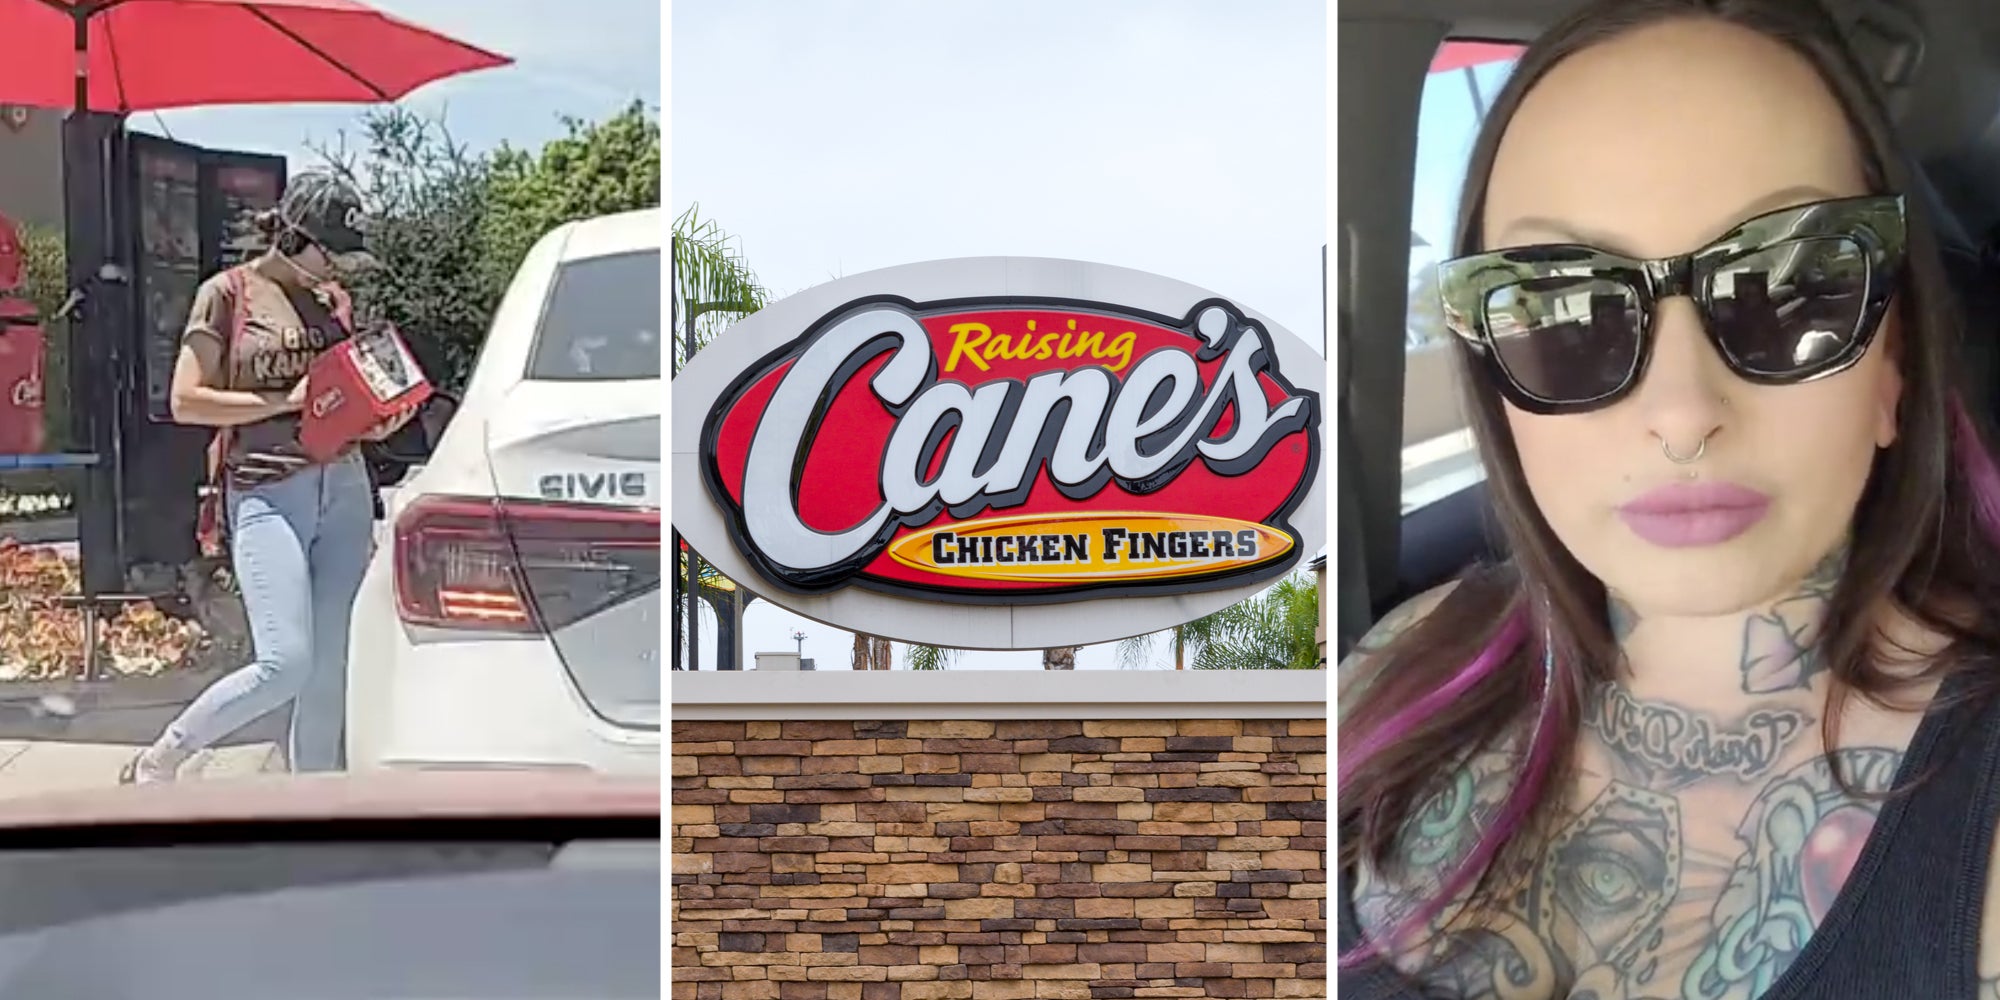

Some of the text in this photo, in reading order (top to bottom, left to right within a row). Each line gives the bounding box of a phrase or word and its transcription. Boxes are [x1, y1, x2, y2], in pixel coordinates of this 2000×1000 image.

[282, 327, 325, 350] BIG
[944, 319, 1137, 372] Raising
[743, 307, 1310, 570] Cane's
